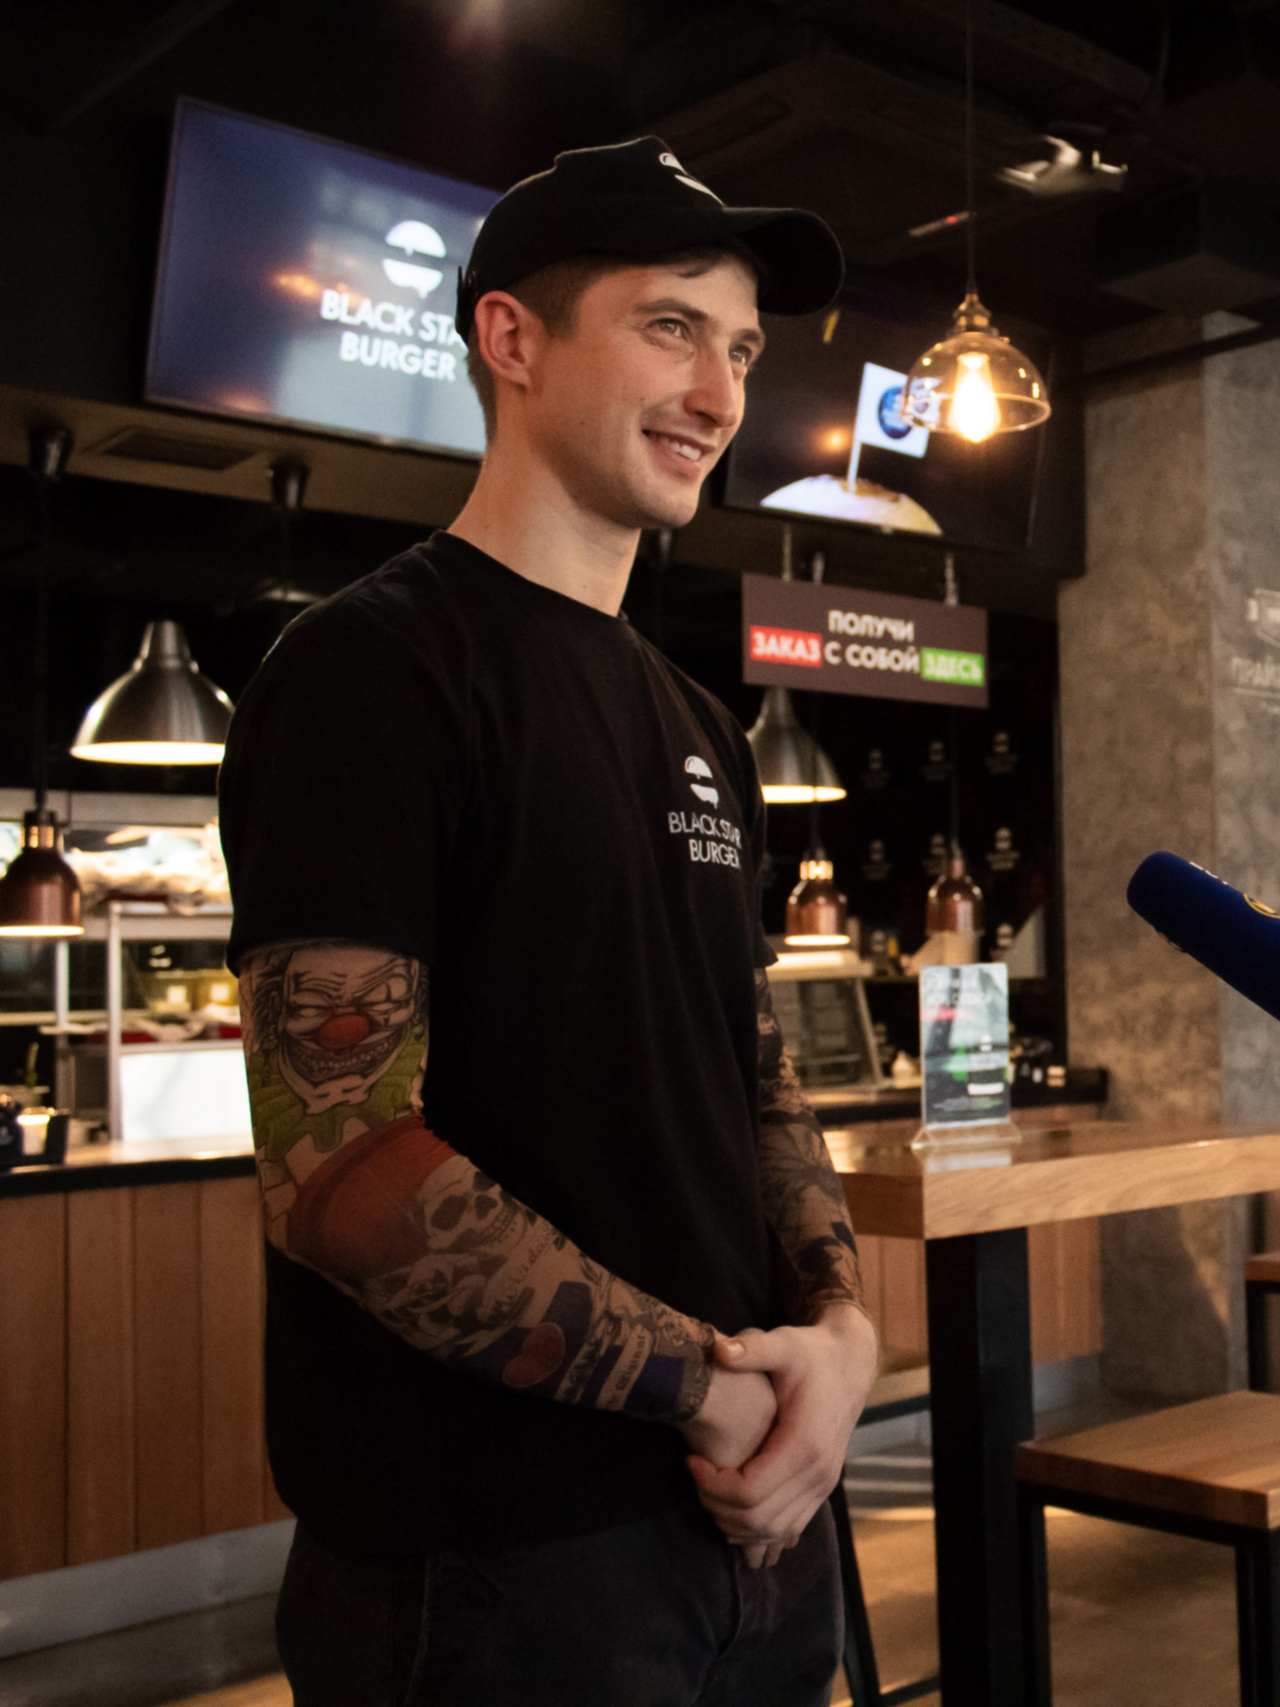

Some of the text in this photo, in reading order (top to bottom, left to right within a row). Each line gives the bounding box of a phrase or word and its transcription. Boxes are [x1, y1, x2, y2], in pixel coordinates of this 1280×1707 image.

[321, 289, 469, 352] BLACK STA
[339, 331, 457, 382] BURGER
[828, 610, 915, 642] ПОЛУЧИ
[753, 632, 982, 681] ЗАКАЗ С СОБОЙ ЗДЕСЬ
[667, 811, 721, 838] BLACK
